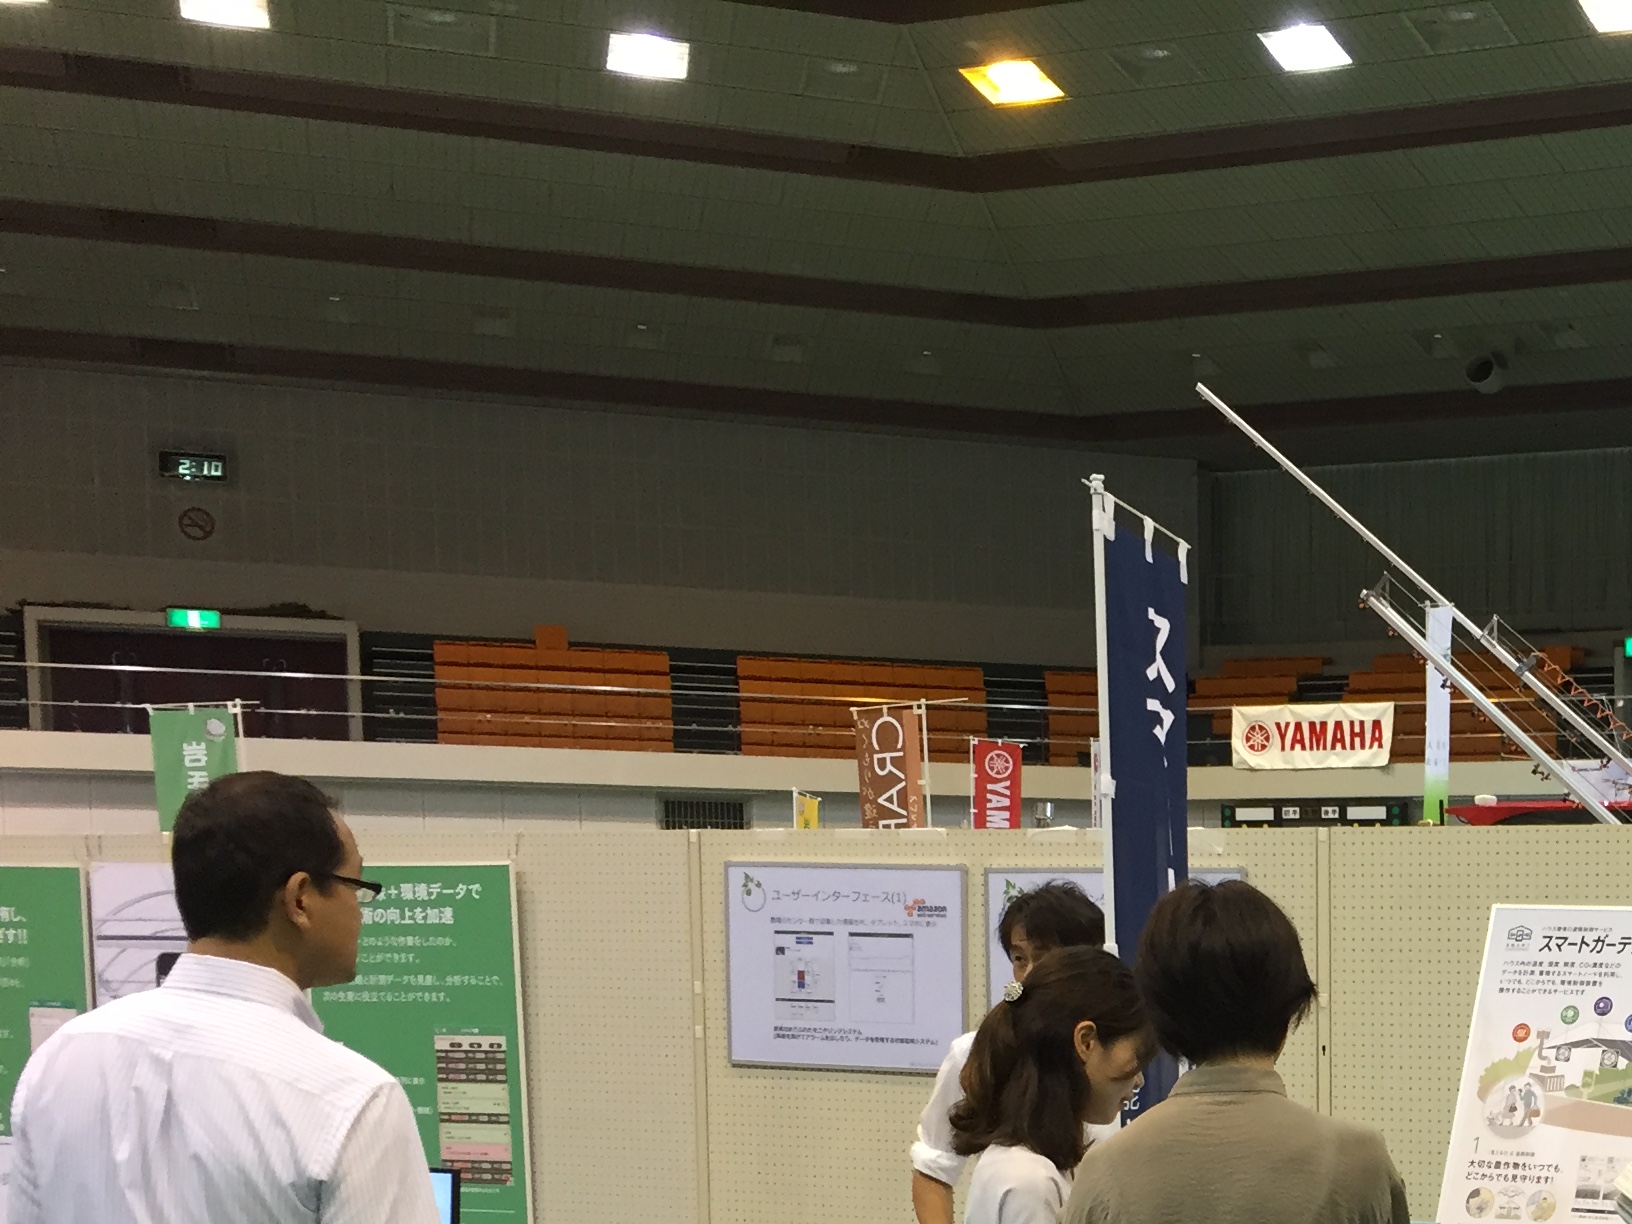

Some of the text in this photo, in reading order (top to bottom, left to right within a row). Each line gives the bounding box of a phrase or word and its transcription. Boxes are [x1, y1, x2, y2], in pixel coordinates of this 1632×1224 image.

[179, 459, 222, 475] 2:10
[1274, 719, 1384, 752] YAMAHA
[917, 905, 947, 913] amazon
